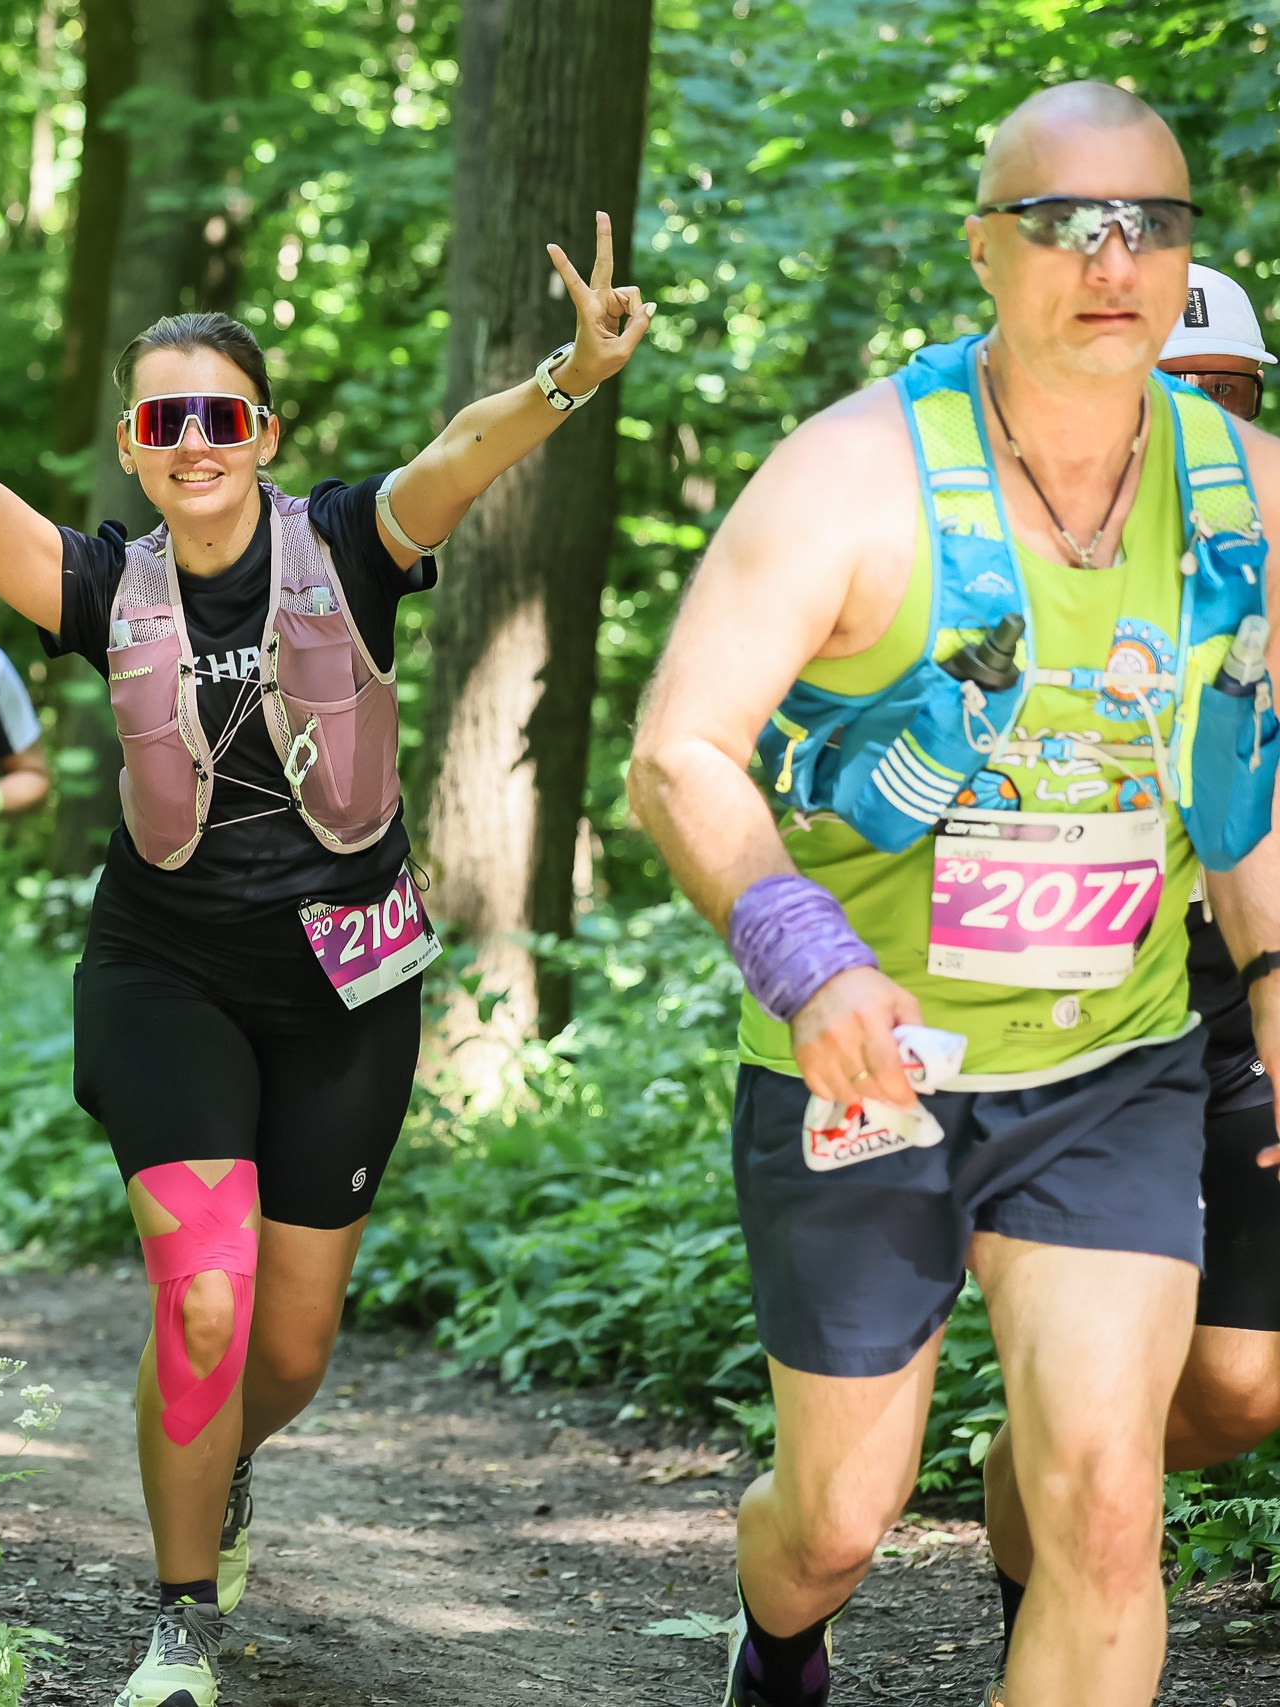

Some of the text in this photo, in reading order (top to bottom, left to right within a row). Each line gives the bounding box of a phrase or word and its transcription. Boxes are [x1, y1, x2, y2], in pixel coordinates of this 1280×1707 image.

[1193, 290, 1204, 325] SALOMON
[111, 665, 153, 680] SALOMON
[937, 860, 980, 884] 20
[959, 867, 1158, 932] 2077
[311, 916, 334, 942] 20
[339, 876, 418, 965] 2104
